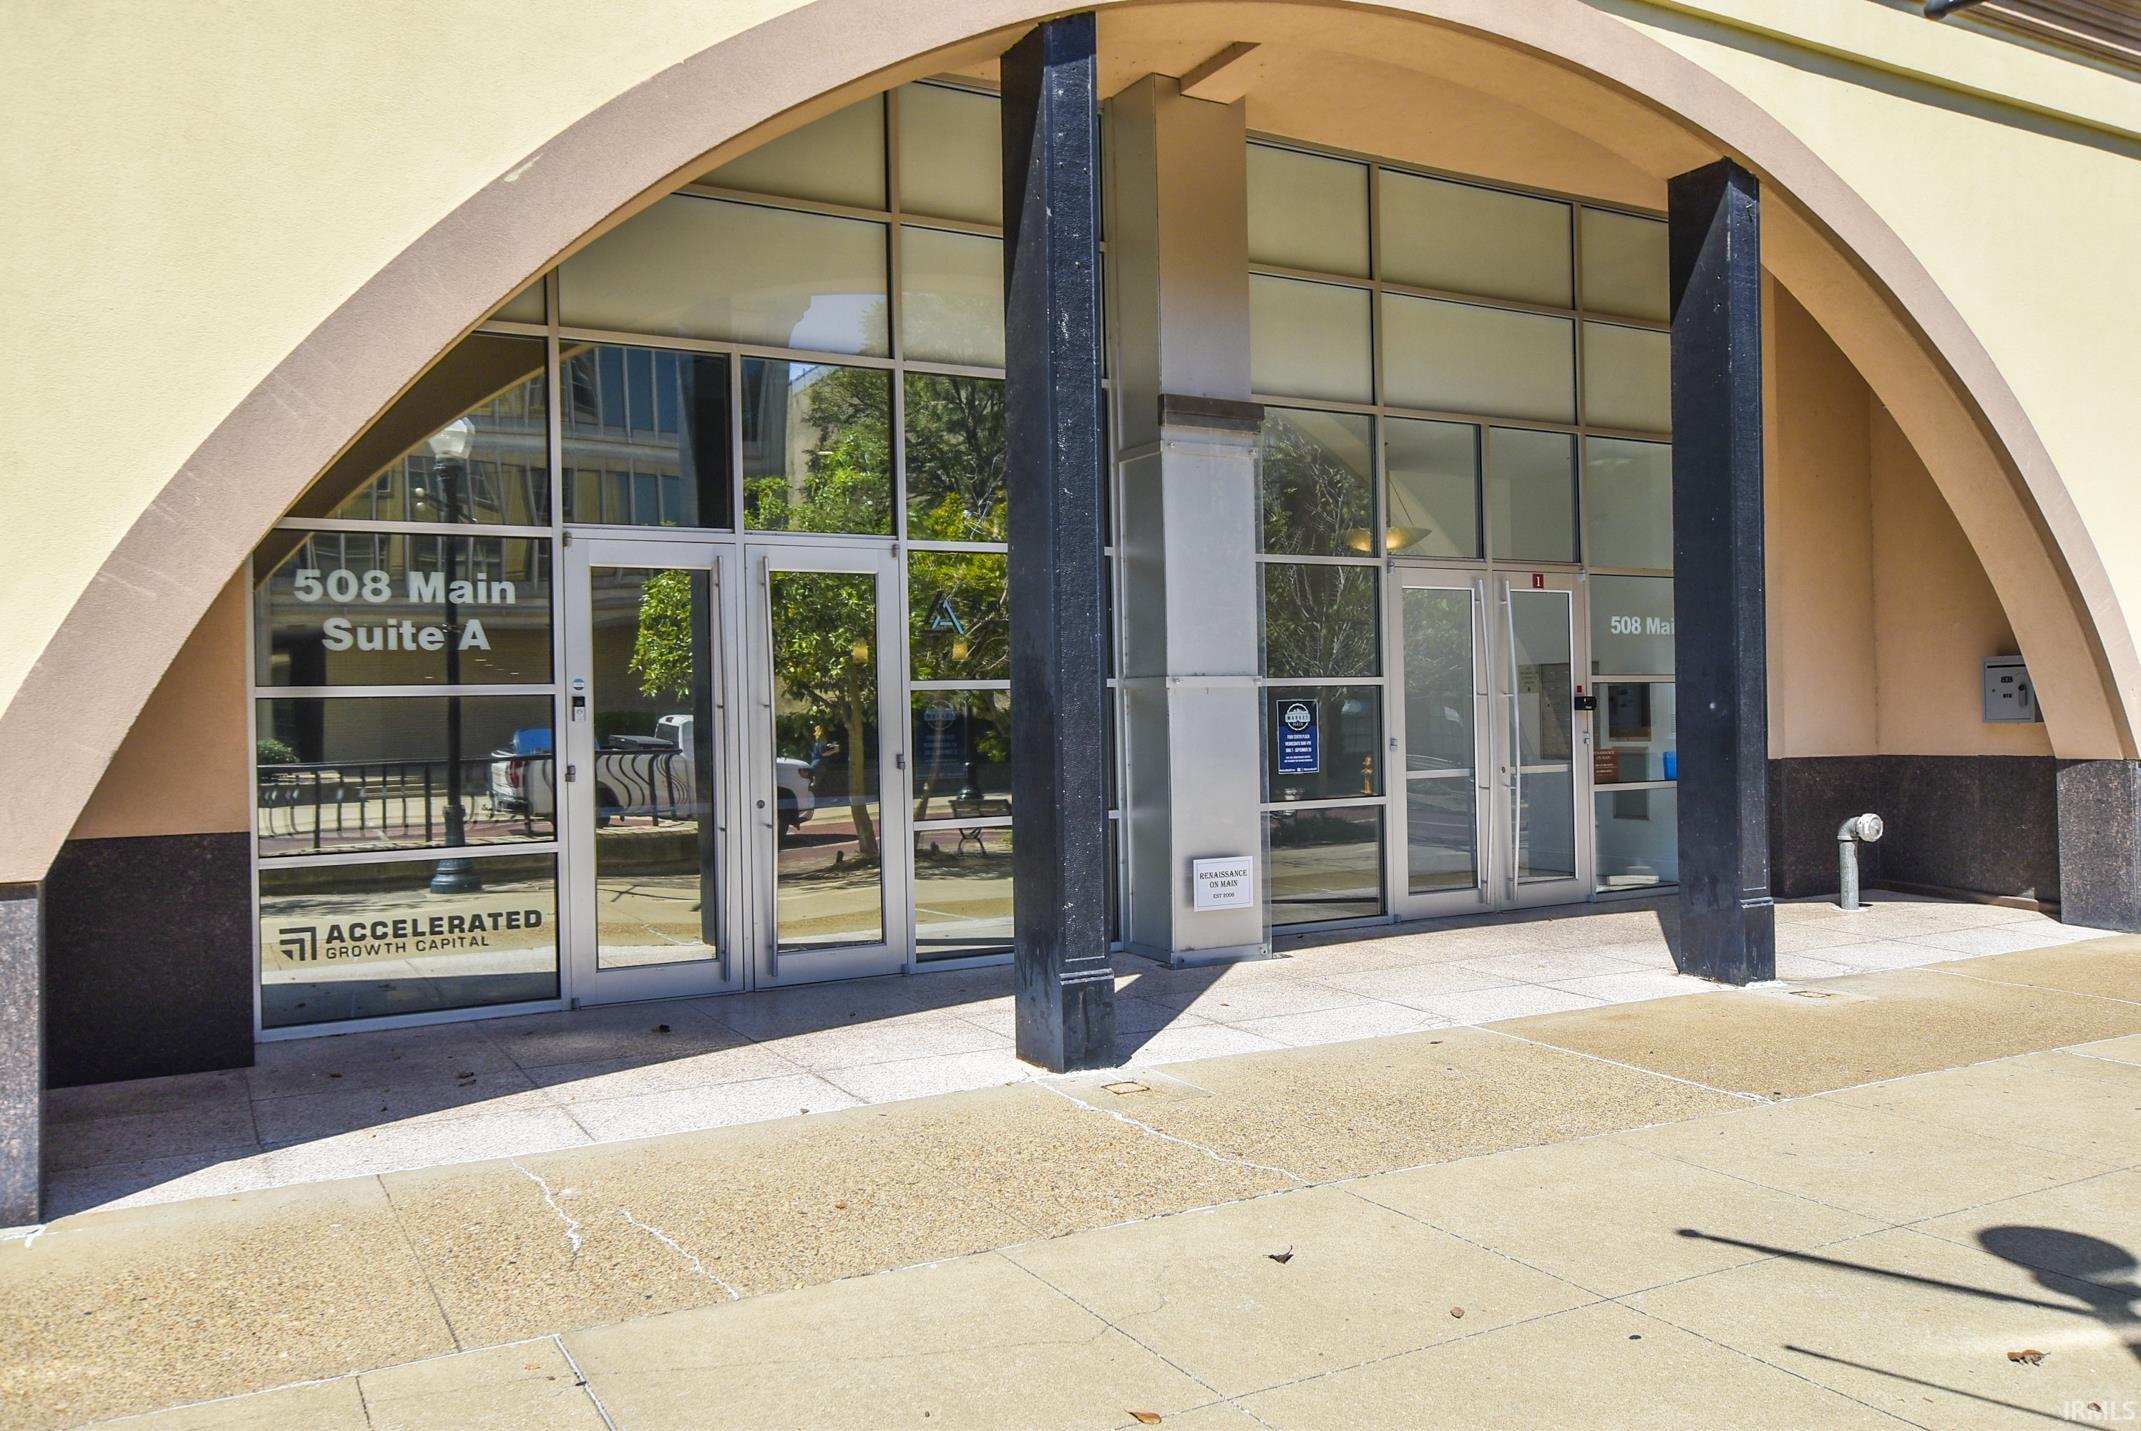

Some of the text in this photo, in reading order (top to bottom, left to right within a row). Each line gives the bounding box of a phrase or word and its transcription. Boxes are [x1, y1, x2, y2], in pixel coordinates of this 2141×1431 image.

[294, 568, 516, 604] 508 Main
[322, 617, 491, 651] Suite A
[1611, 616, 1675, 635] 508 Mai
[1200, 870, 1248, 879] RENAISSANCE
[326, 909, 542, 944] ACCELERATED
[326, 936, 490, 960] GROWTH CAPITAL
